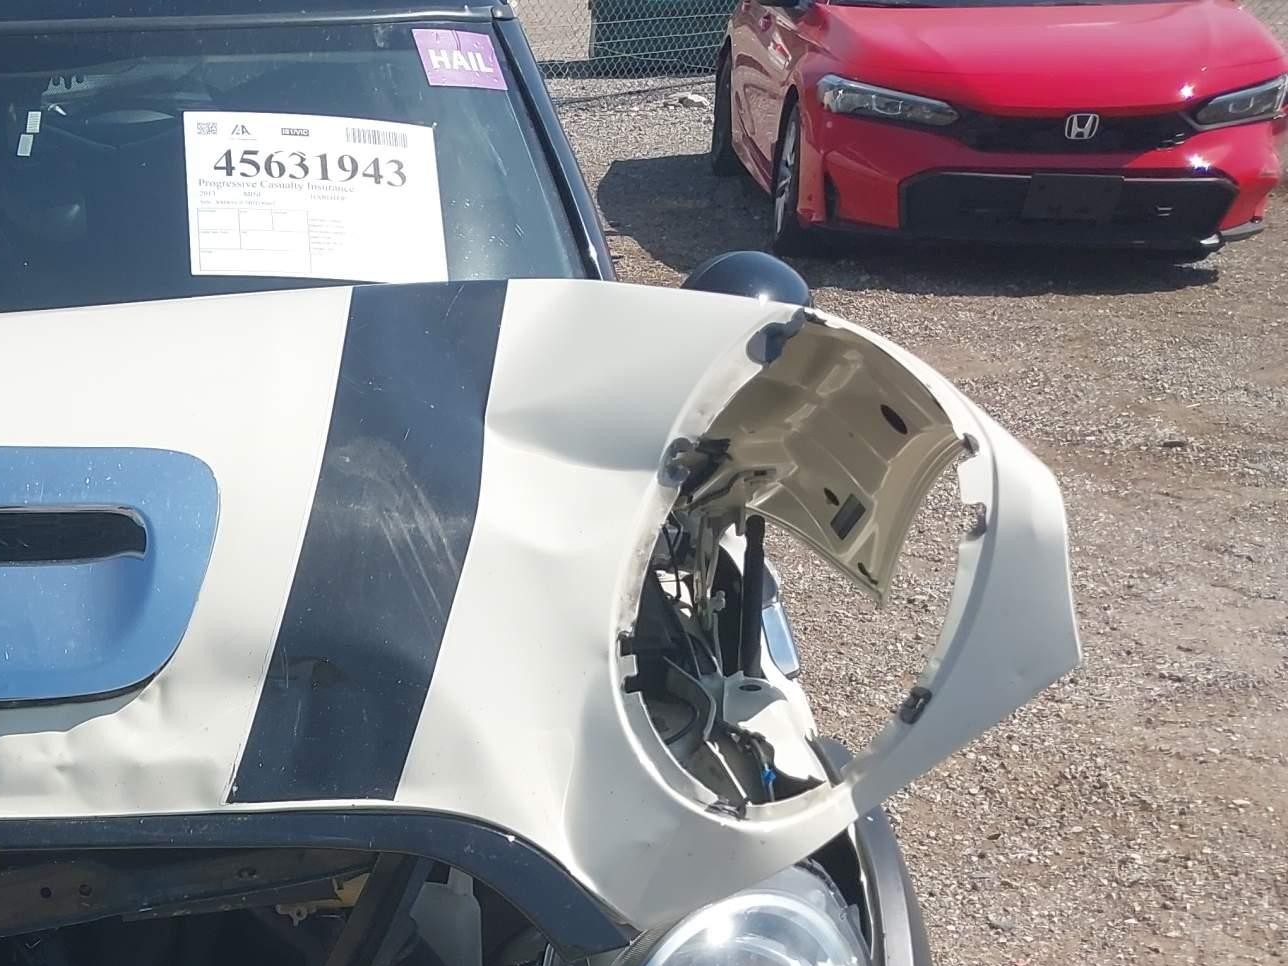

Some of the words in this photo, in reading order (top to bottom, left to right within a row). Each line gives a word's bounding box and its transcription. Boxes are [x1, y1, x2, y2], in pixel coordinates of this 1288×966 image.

[427, 49, 494, 73] HAIL
[213, 149, 407, 187] 45631943
[198, 178, 257, 191] Progressive
[260, 180, 304, 192] Casualty
[307, 182, 355, 193] Insurance
